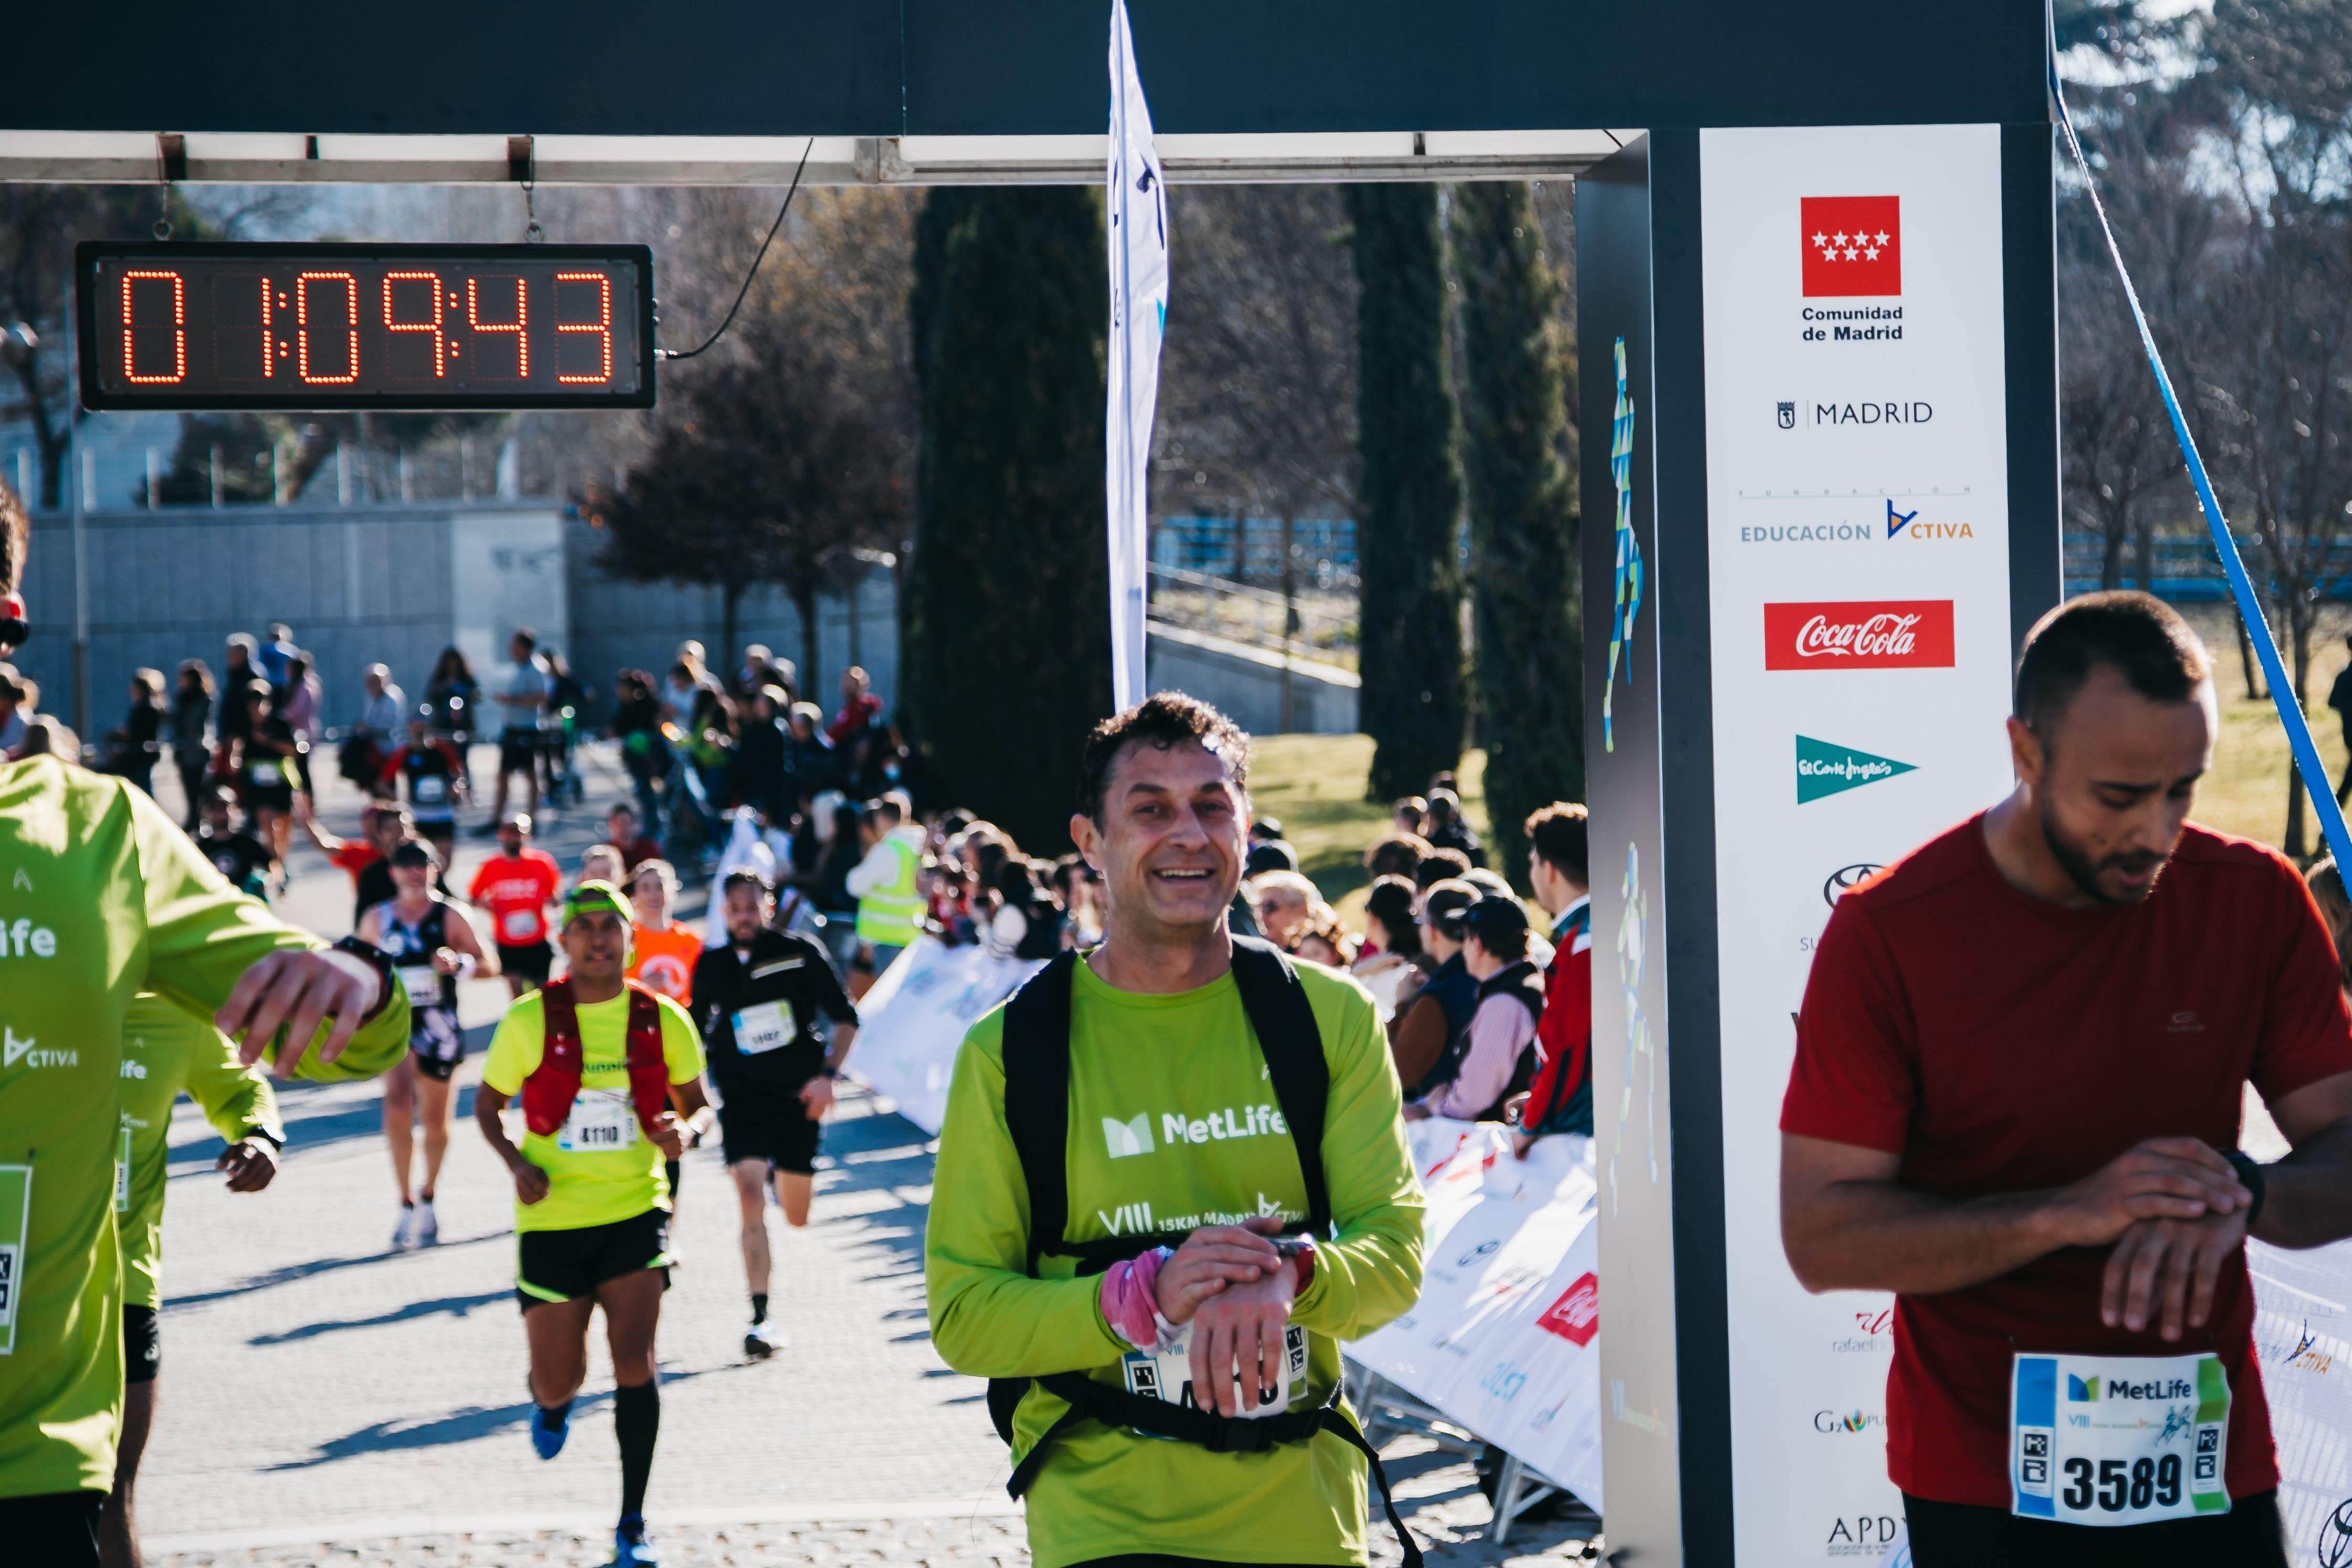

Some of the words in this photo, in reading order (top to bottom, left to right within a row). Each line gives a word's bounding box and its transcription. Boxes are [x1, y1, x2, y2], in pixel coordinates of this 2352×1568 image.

[1802, 307, 1902, 320] Comunidad
[1802, 327, 1826, 340] de
[1834, 326, 1902, 340] Madrid
[1816, 402, 1932, 424] MADRID
[1741, 519, 1871, 542] EDUCACIÓN
[0, 918, 56, 957] ife
[120, 1059, 148, 1079] ife
[1162, 1104, 1287, 1144] MetLife
[1098, 1201, 1154, 1237] VIII
[1158, 1215, 1200, 1231] 15KM
[2108, 1379, 2191, 1400] MetLife
[2068, 1414, 2090, 1428] VIII
[2064, 1454, 2182, 1512] 3589
[1827, 1517, 1908, 1543] APD
